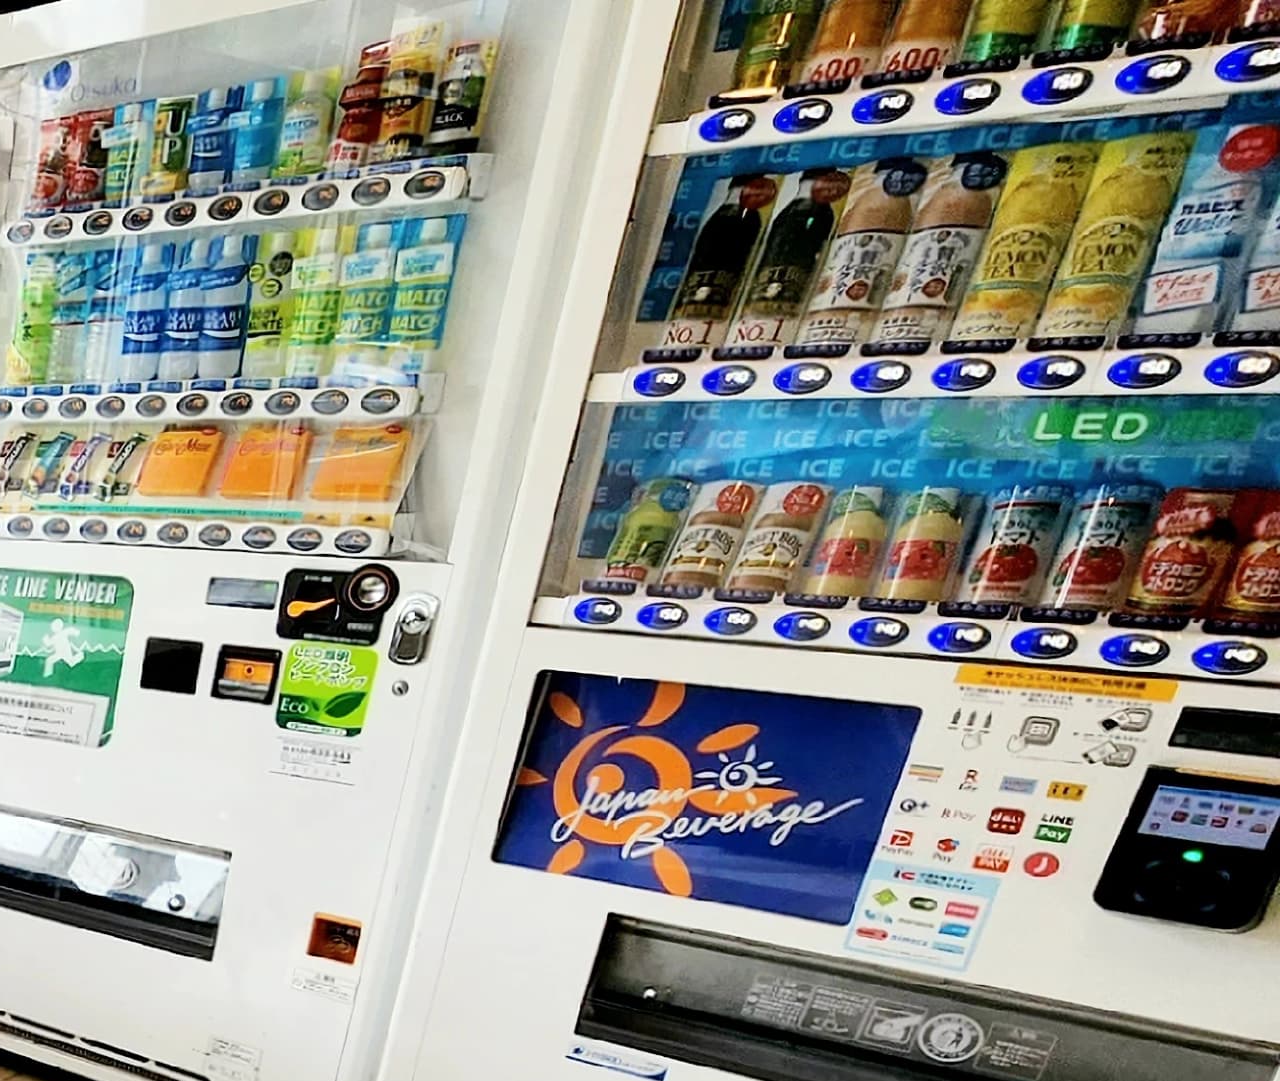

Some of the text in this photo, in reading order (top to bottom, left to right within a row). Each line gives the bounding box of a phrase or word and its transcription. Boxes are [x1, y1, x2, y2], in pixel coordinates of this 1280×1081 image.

[904, 131, 952, 153] ICE
[975, 125, 1028, 149] ICE
[759, 143, 803, 164] ICE
[828, 138, 877, 159] ICE
[620, 405, 659, 422] ICE
[683, 403, 723, 421] ICE
[747, 401, 791, 420] ICE
[816, 400, 861, 418] ICE
[1033, 412, 1149, 441] LED
[644, 431, 685, 450] ICE
[706, 430, 749, 449] ICE
[773, 429, 818, 449] ICE
[844, 428, 890, 448] ICE
[607, 459, 646, 477] ICE
[669, 459, 711, 477] ICE
[732, 459, 774, 478] ICE
[800, 458, 845, 478] ICE
[871, 458, 918, 478] ICE
[946, 458, 994, 478] ICE
[1026, 458, 1078, 479] ICE
[1102, 455, 1158, 473] ICE
[14, 577, 48, 599] LINE
[54, 579, 117, 604] VENDER
[551, 776, 716, 844] Japan
[1041, 814, 1074, 826] LINE
[618, 797, 866, 859] Beverage
[1040, 828, 1068, 841] Pay
